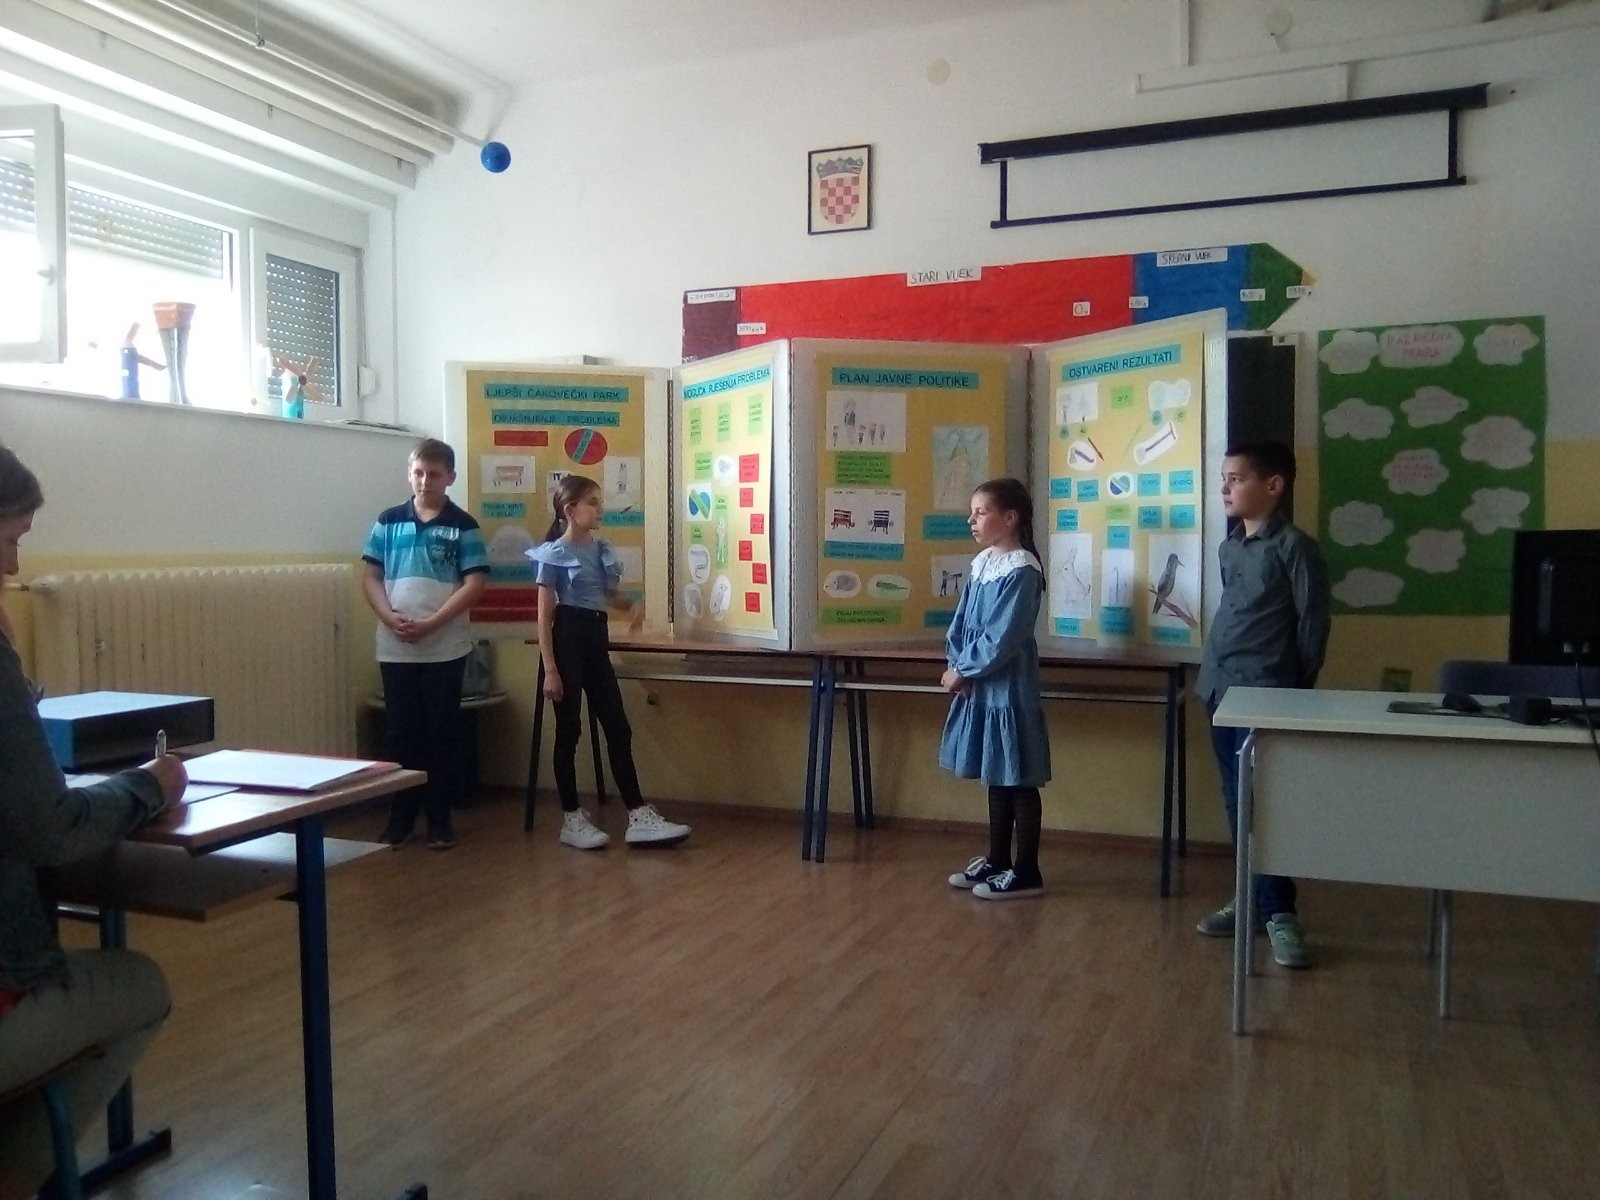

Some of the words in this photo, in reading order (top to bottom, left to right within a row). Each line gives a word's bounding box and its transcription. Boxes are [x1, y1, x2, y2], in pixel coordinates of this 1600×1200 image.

[910, 271, 939, 285] STARI
[946, 269, 974, 282] VIJEK
[1069, 360, 1119, 378] OSTVARENI
[1122, 351, 1172, 369] REZULTATI
[737, 368, 770, 384] PROBLEMA
[839, 373, 870, 384] PLAN
[876, 373, 912, 384] JAVNE
[918, 375, 969, 387] POLITIKE
[593, 391, 620, 401] PARK
